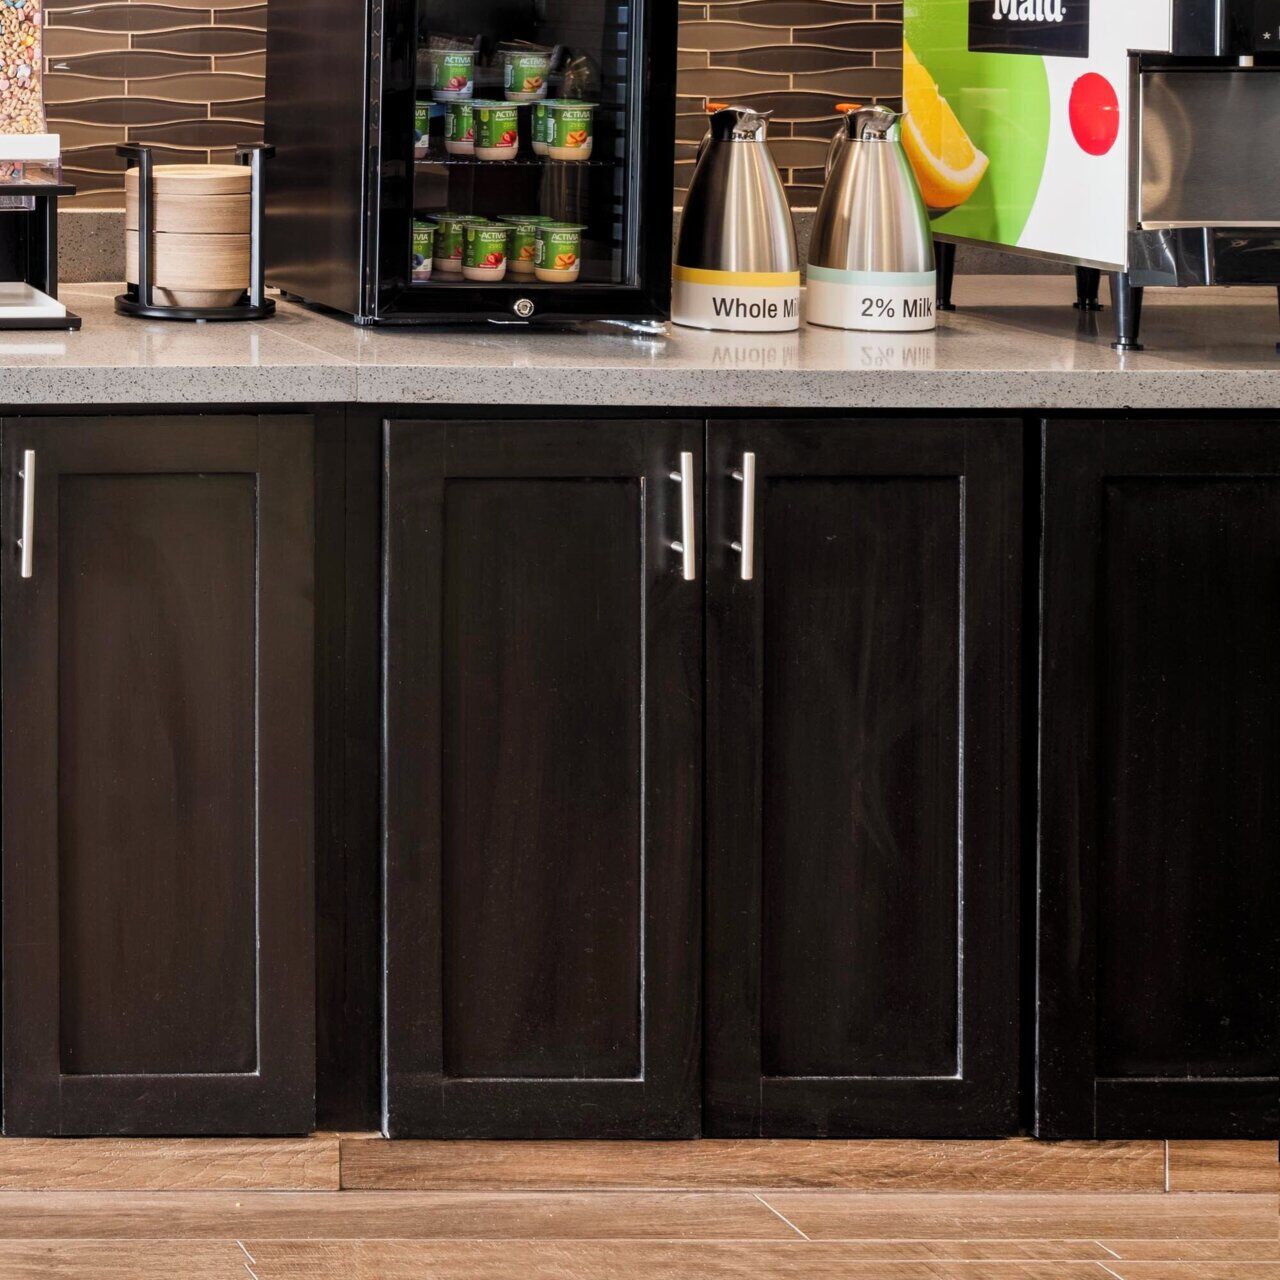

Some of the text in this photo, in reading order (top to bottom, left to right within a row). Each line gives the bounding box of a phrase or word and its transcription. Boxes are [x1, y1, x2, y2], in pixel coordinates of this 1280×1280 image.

[712, 296, 778, 319] Whole
[861, 297, 933, 318] 2% Milk
